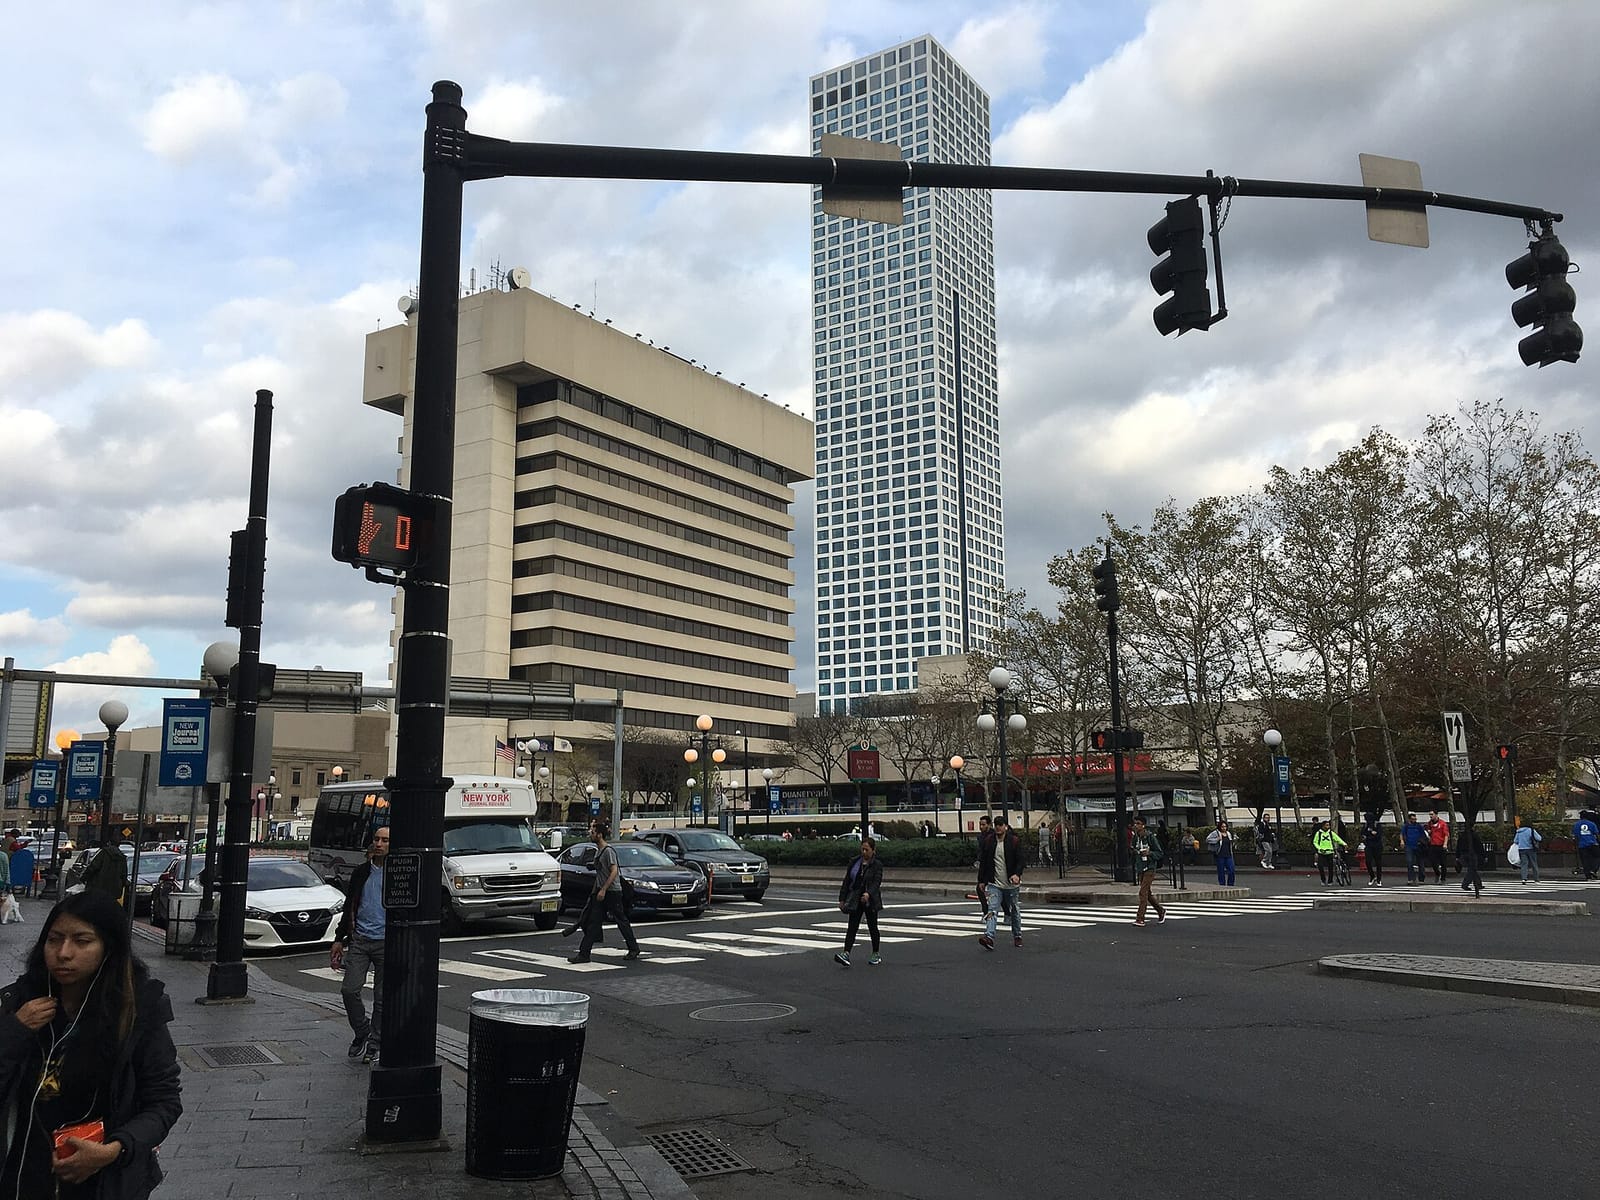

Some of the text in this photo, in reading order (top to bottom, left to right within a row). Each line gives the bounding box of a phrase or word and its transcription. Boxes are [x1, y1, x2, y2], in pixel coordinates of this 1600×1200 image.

[173, 728, 200, 736] Journal
[173, 736, 198, 745] Square
[463, 794, 510, 802] NEW YORK
[392, 857, 413, 865] PUSH
[387, 865, 417, 873] BUTTON
[393, 873, 411, 881] WAIT
[394, 881, 409, 889] FOR
[390, 889, 412, 897] WALK
[387, 897, 415, 905] SIGNAL
